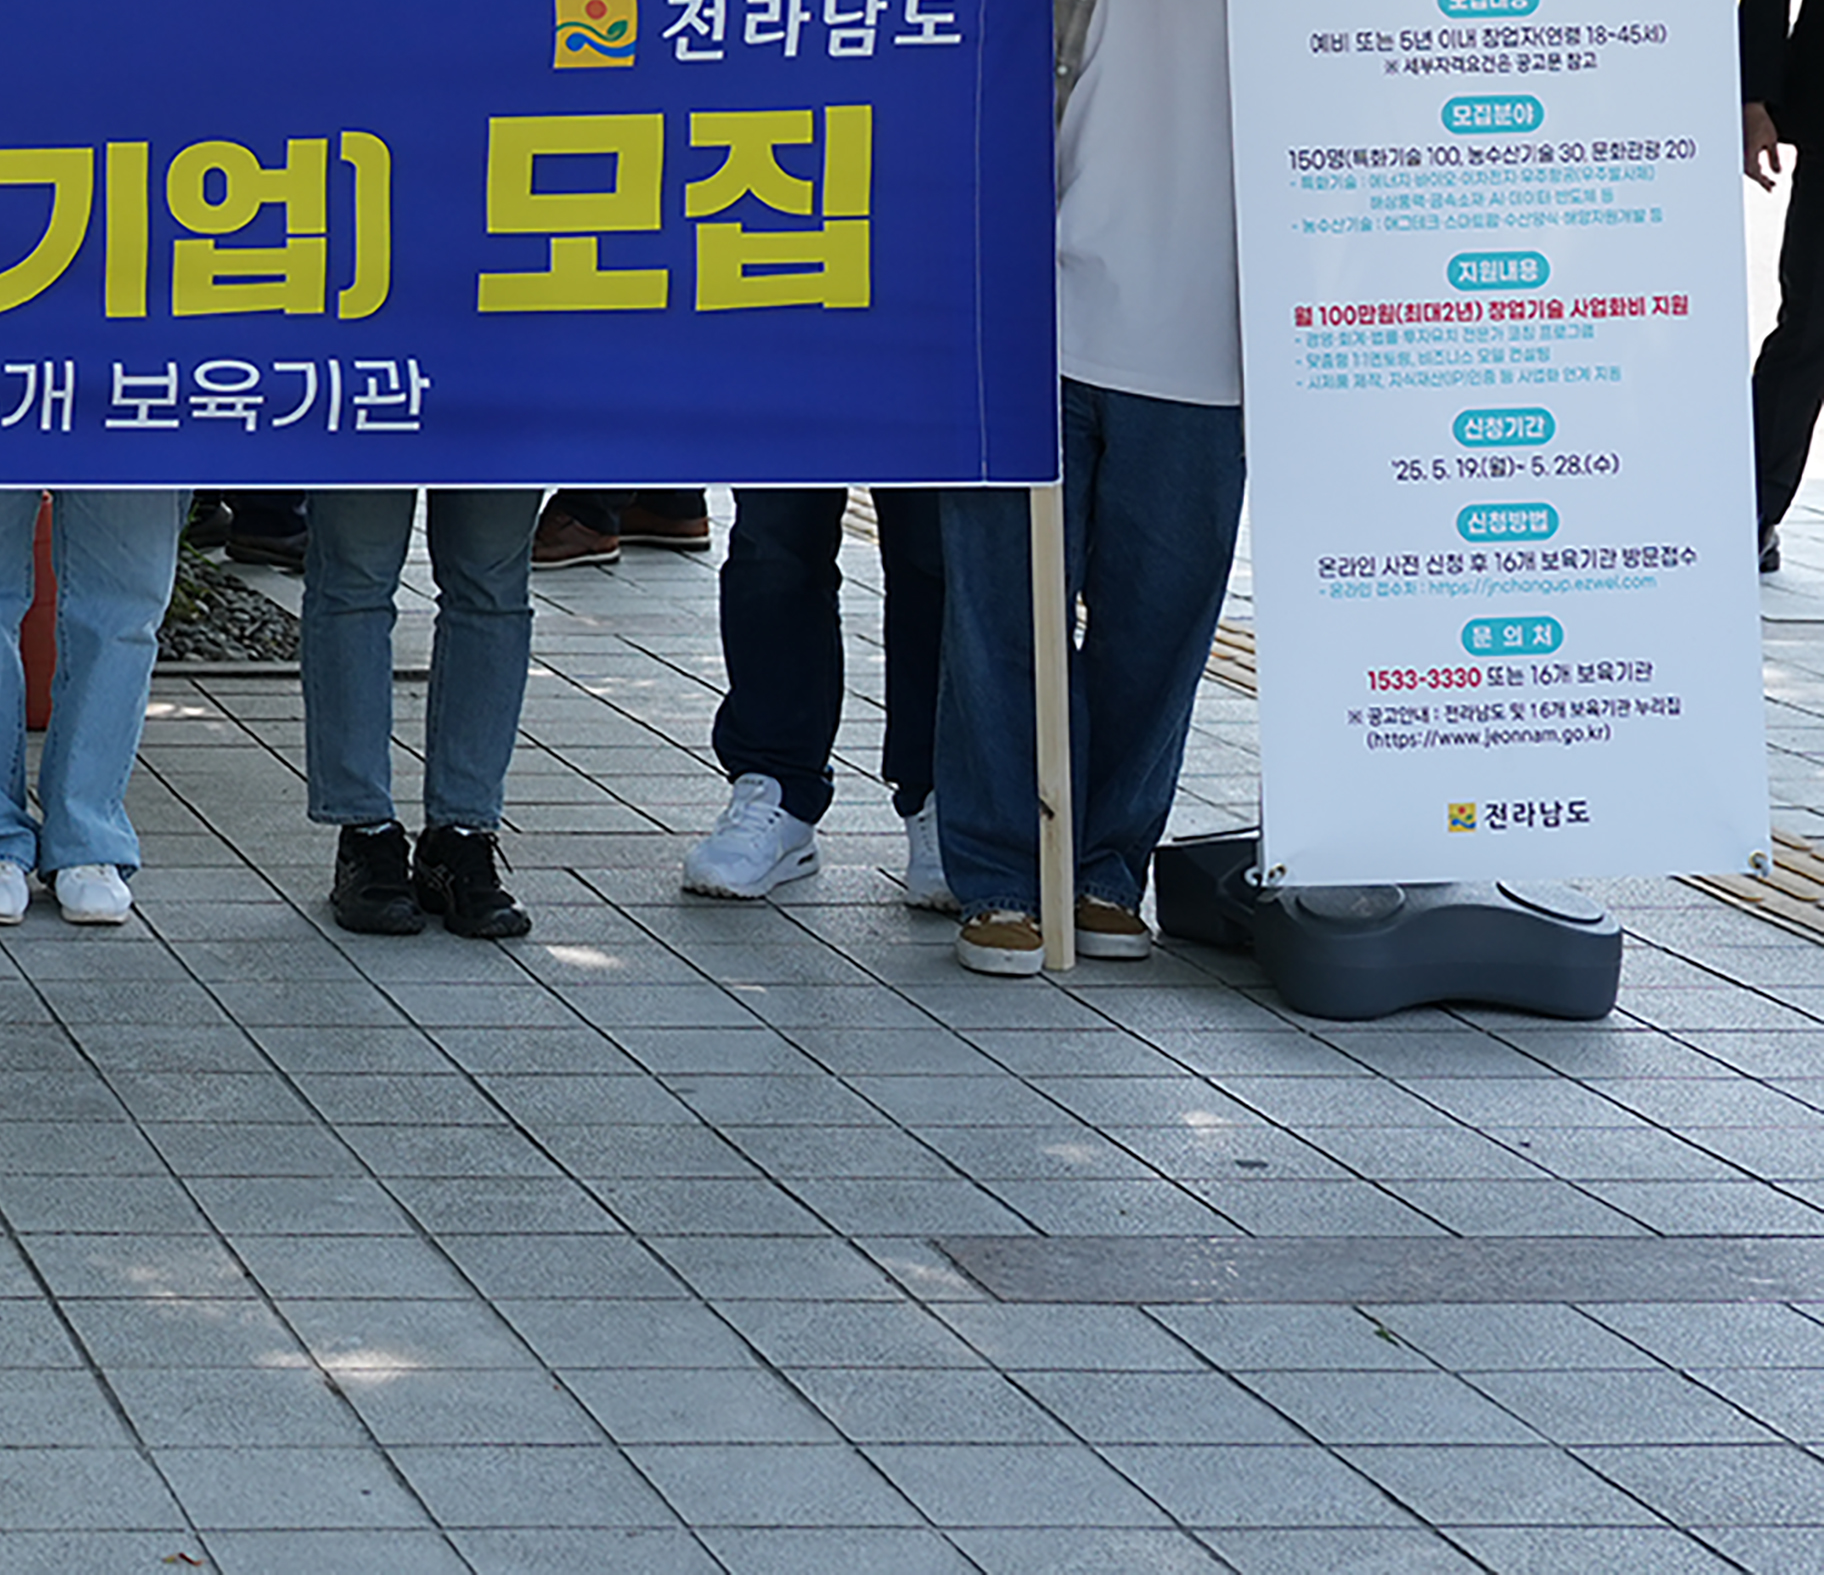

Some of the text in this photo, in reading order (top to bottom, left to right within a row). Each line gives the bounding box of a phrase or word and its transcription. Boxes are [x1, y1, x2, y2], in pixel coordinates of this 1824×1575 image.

[1453, 103, 1533, 126] 모집분야
[478, 105, 872, 312] 모집
[1459, 259, 1538, 282] 지원내용
[1295, 307, 1312, 326] 월
[1490, 299, 1563, 320] 창업기술
[1571, 297, 1645, 317] 사업화비
[1653, 295, 1687, 315] 지원
[106, 359, 430, 431] 보육기관
[1465, 416, 1545, 439] 신청기간
[1319, 547, 1695, 578] 온라인 사전 신청 후 16개 보육기관 방문접수
[1368, 662, 1652, 690] 1533-3330 또는 16개 보육기관
[1367, 724, 1610, 749] (https://www.jeonnam.go.kr)
[1485, 801, 1589, 829] 전라남도
